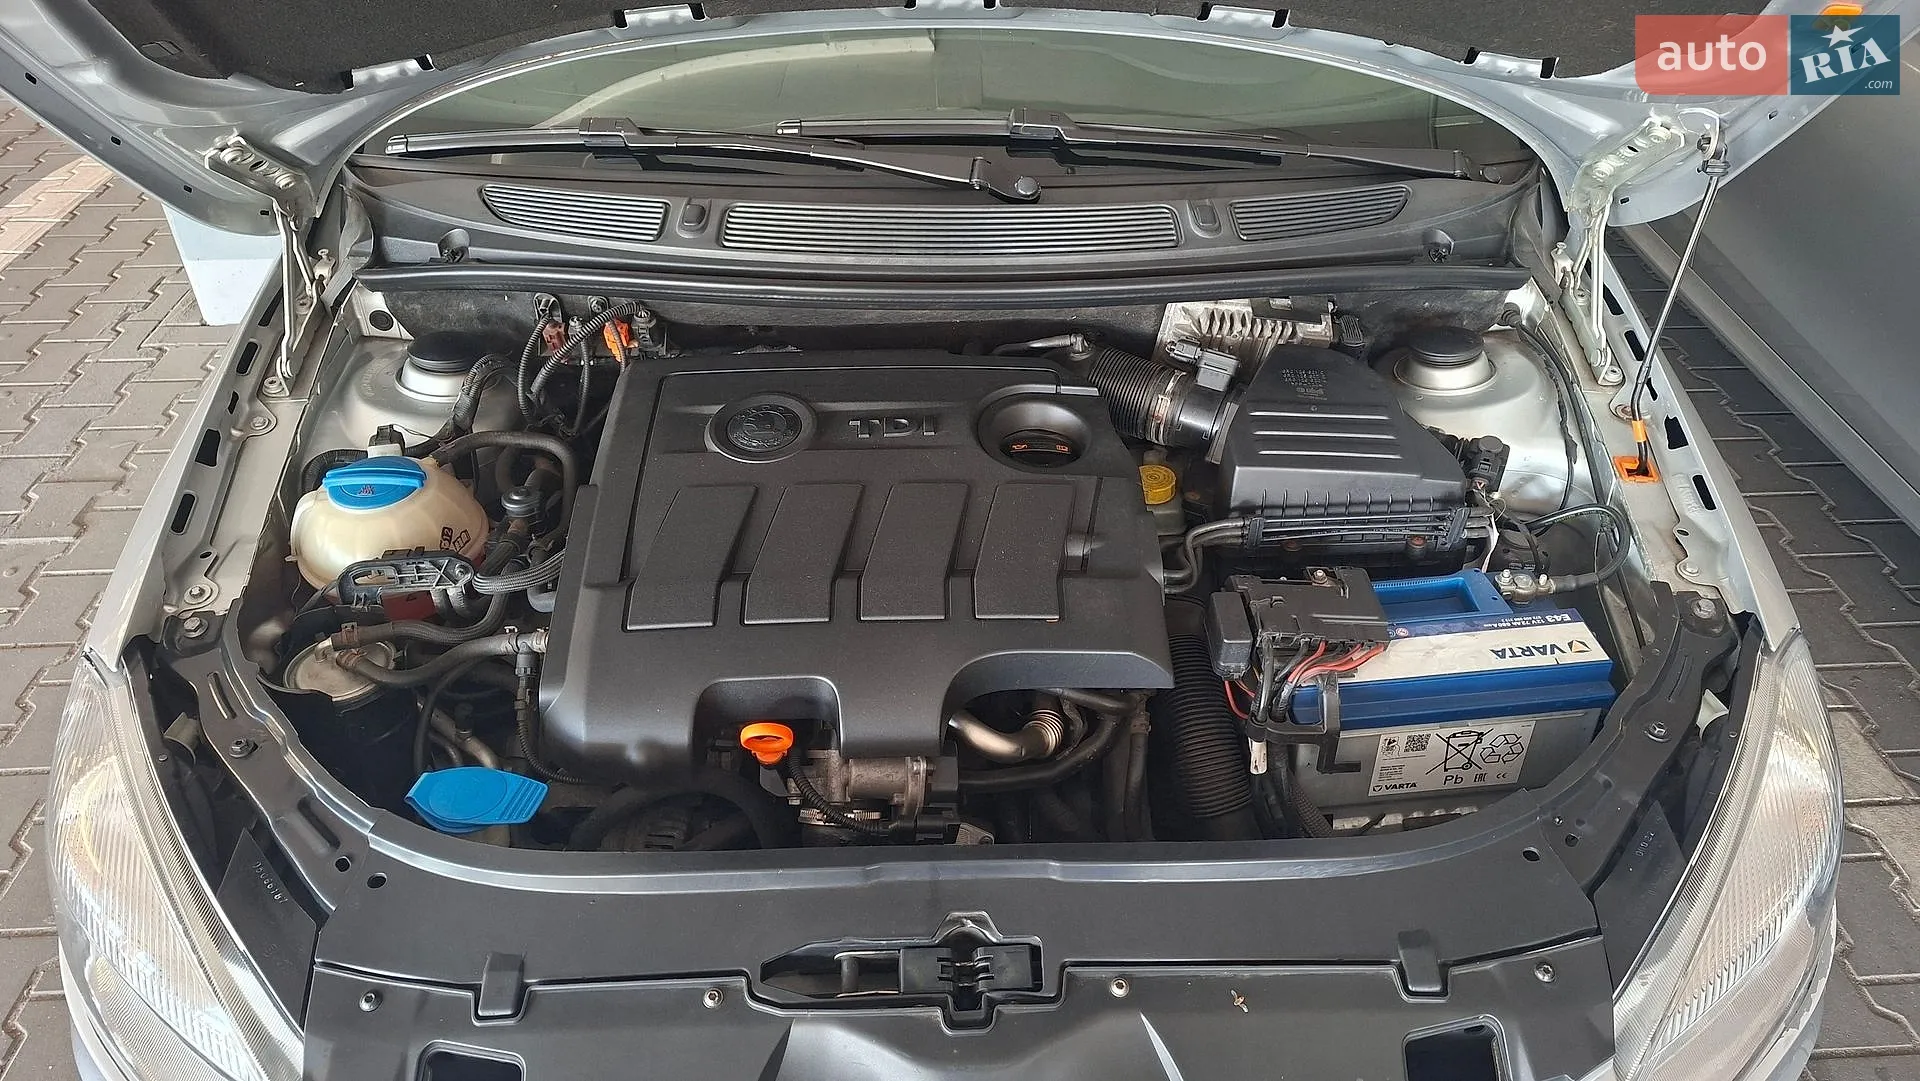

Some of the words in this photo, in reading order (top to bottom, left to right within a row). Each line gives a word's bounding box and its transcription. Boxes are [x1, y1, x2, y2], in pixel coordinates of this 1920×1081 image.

[848, 415, 937, 438] TDI
[1545, 613, 1572, 623] E43
[1489, 643, 1567, 659] VARTA
[1443, 774, 1464, 785] Pb
[1384, 781, 1418, 790] VARTA
